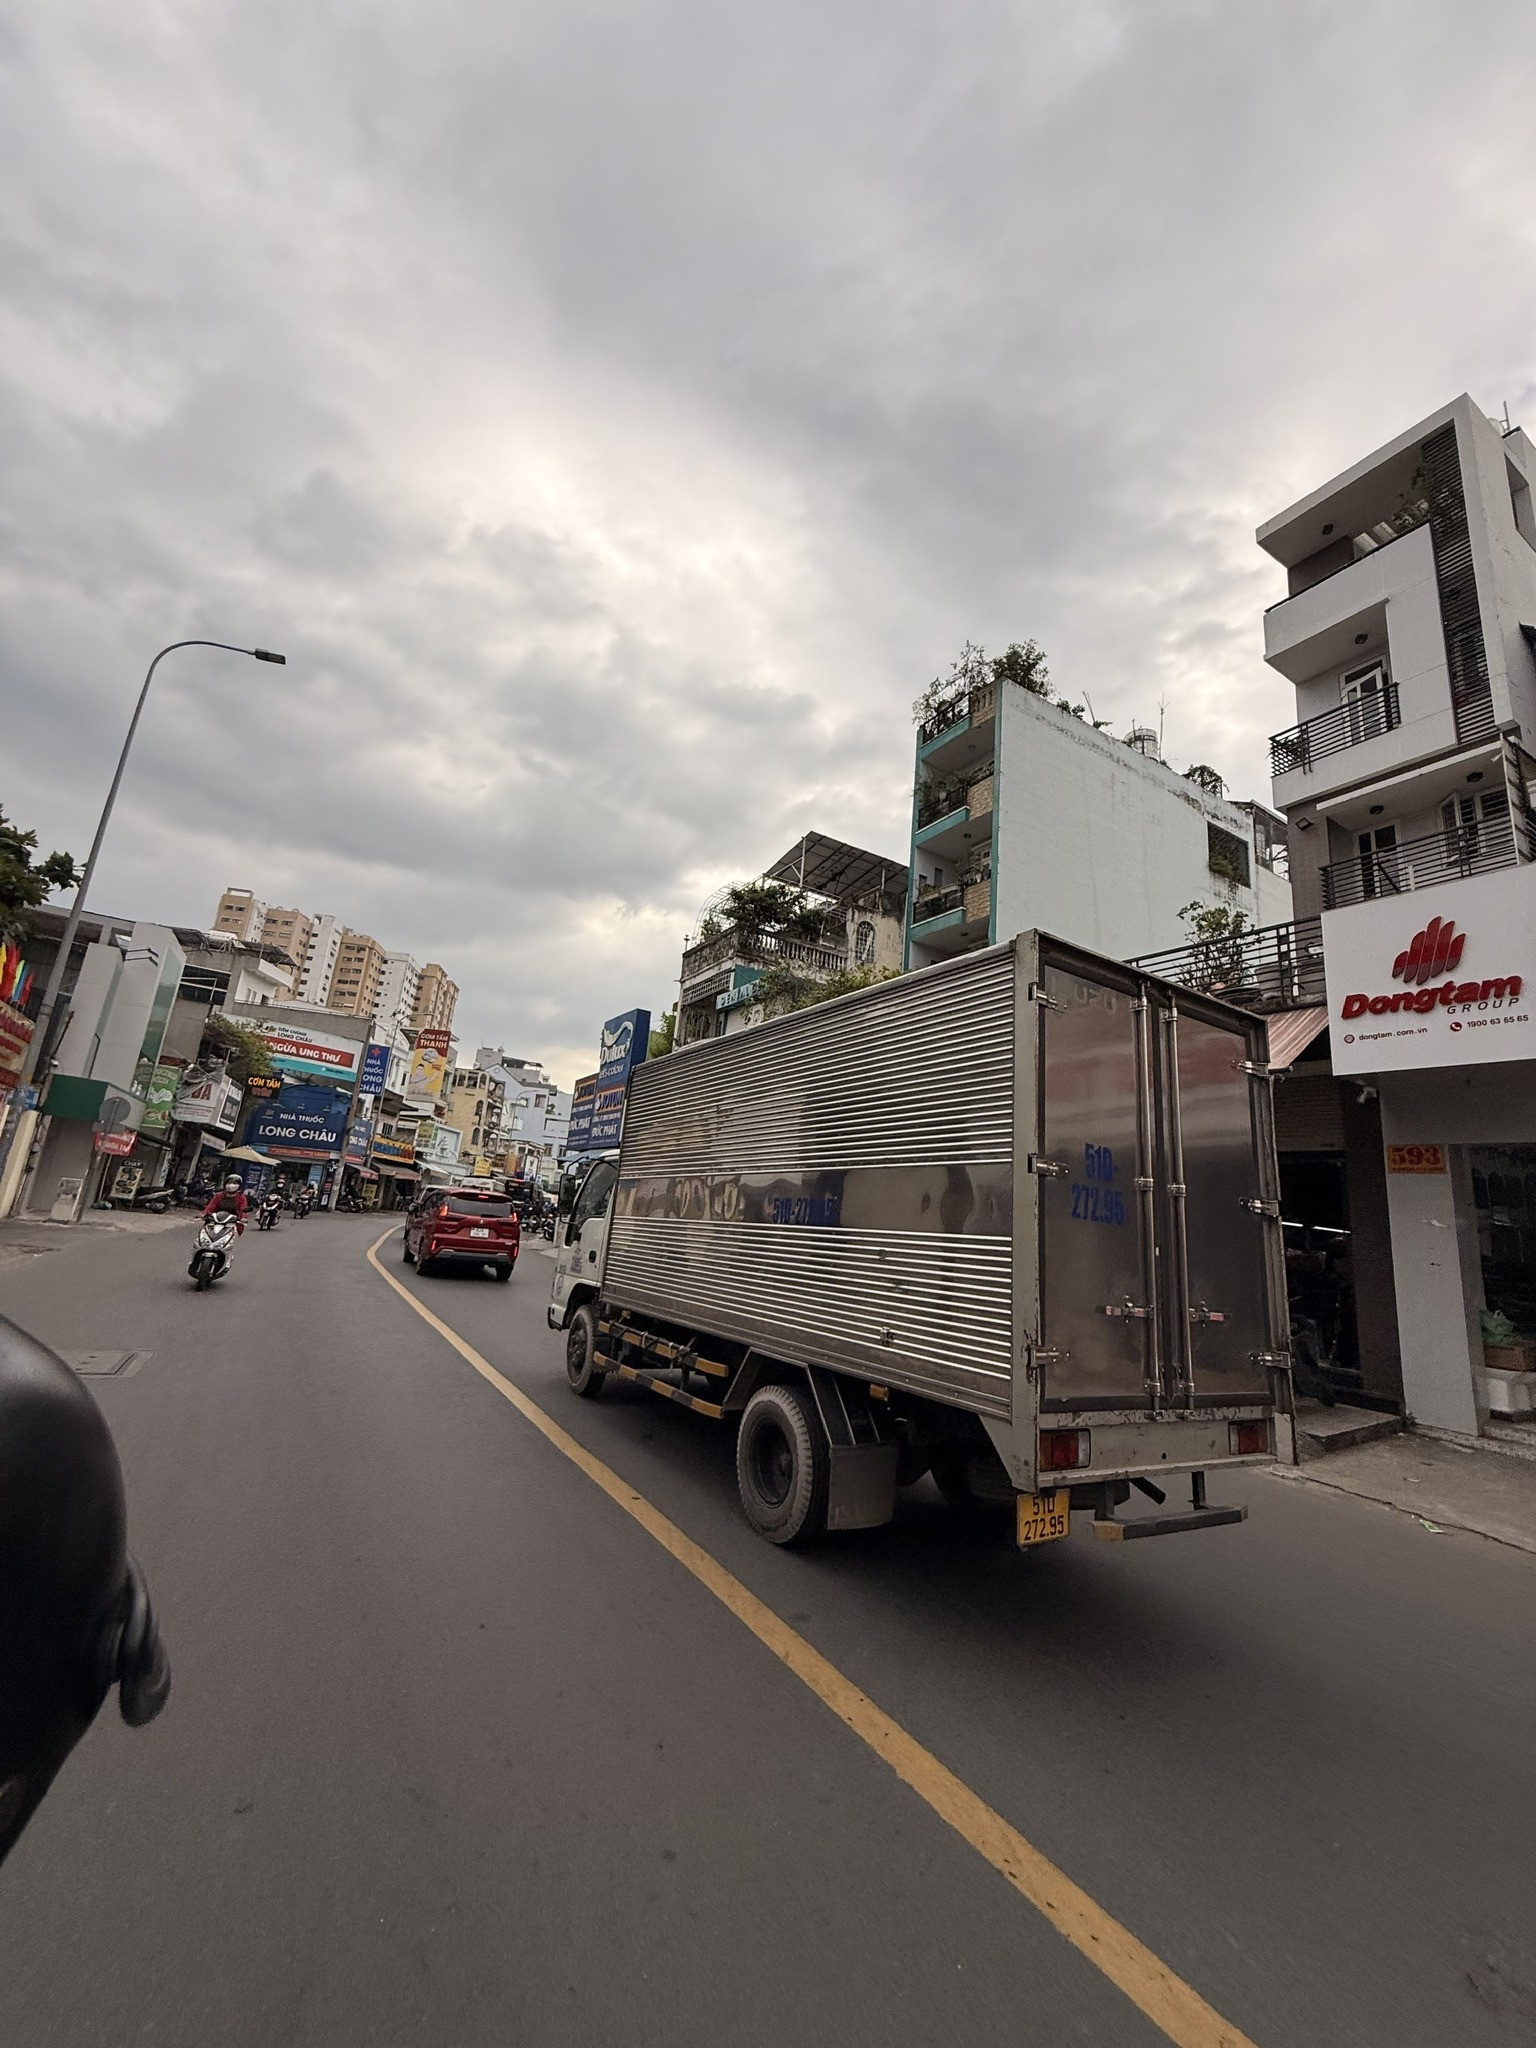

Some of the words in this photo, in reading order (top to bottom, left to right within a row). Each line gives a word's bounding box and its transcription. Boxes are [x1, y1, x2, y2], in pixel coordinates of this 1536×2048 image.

[1341, 975, 1522, 1020] Dongtam
[1447, 998, 1519, 1014] GROUP
[1466, 1019, 1488, 1028] 1900
[1489, 1017, 1501, 1025] 63
[1503, 1016, 1515, 1024] 65
[1516, 1014, 1529, 1022] 65
[420, 1039, 447, 1048] THANH
[299, 1047, 319, 1058] UNG
[321, 1052, 341, 1062] THƯ
[600, 1043, 626, 1064] Dulux
[362, 1074, 382, 1083] ONG
[298, 1115, 325, 1124] THUỐC
[259, 1125, 296, 1138] LONG
[299, 1129, 337, 1143] CHÂU
[1391, 1146, 1441, 1165] 593
[1024, 1515, 1065, 1541] 272.95
